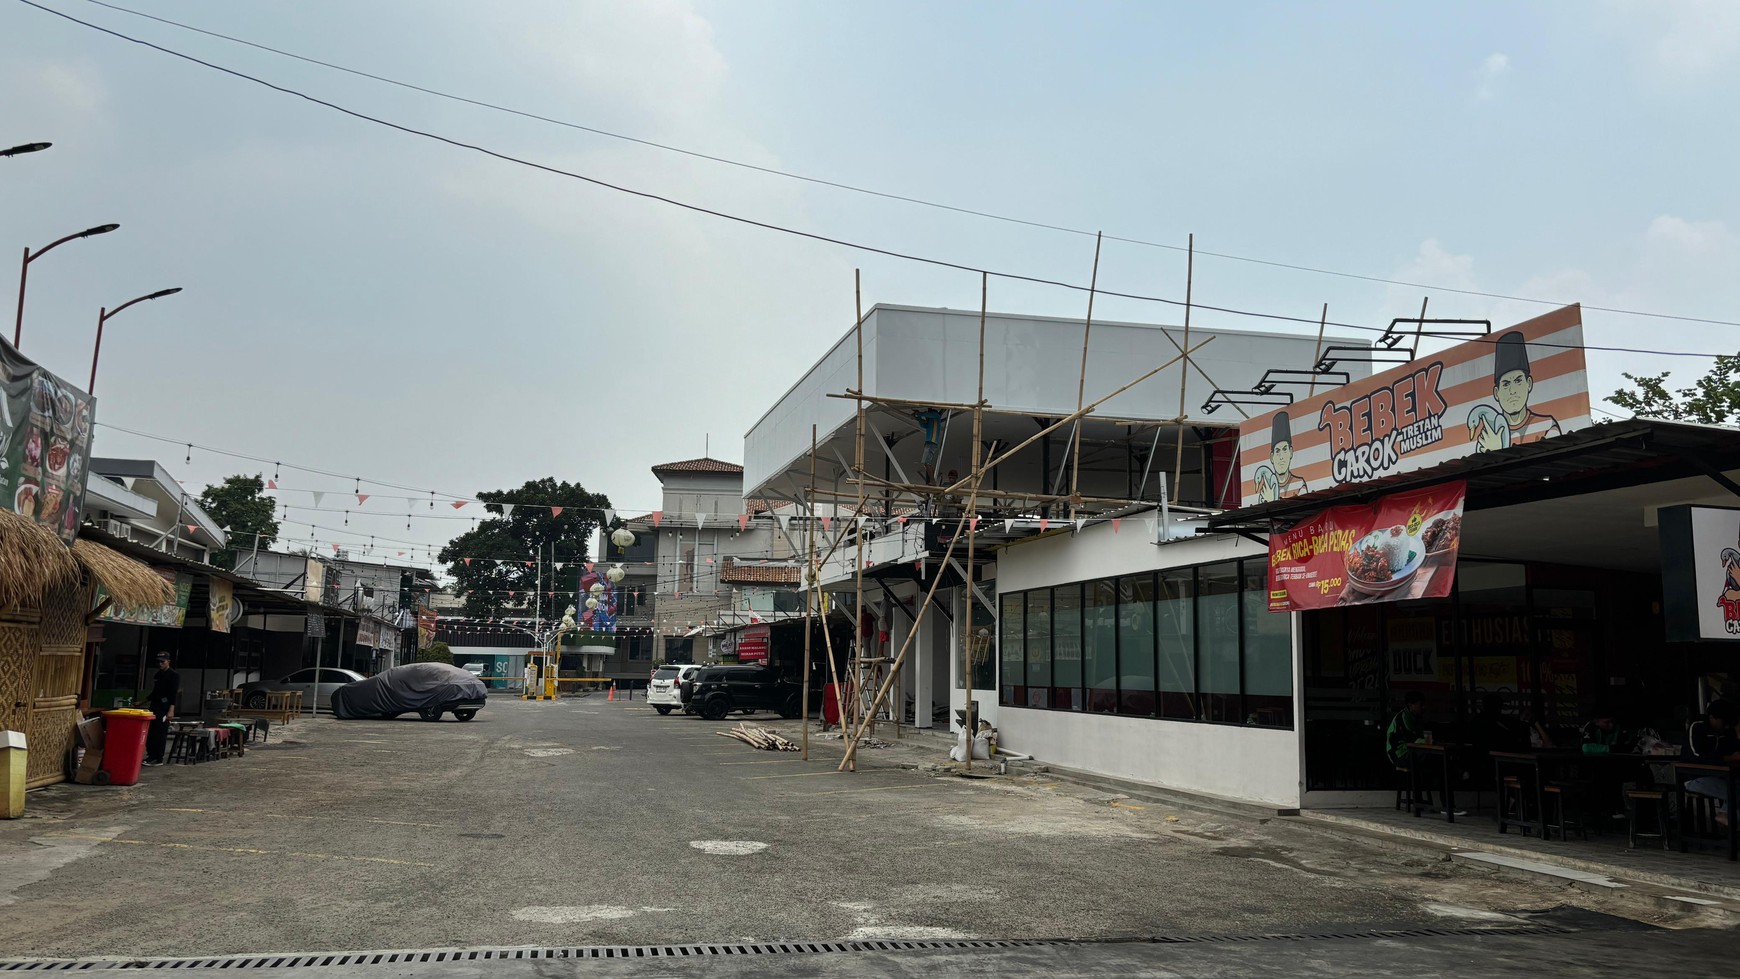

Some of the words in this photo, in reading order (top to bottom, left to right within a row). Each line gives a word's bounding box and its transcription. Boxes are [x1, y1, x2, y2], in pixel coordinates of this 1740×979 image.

[1319, 363, 1446, 457] BEBEK
[1400, 426, 1442, 454] MUSLIM
[1402, 415, 1439, 440] TRETAN
[1332, 430, 1398, 482] CAROK
[1283, 529, 1304, 545] MENU
[1292, 533, 1328, 560] RICA-RICA
[1329, 529, 1356, 553] PEDAS
[1392, 648, 1434, 675] DUCK
